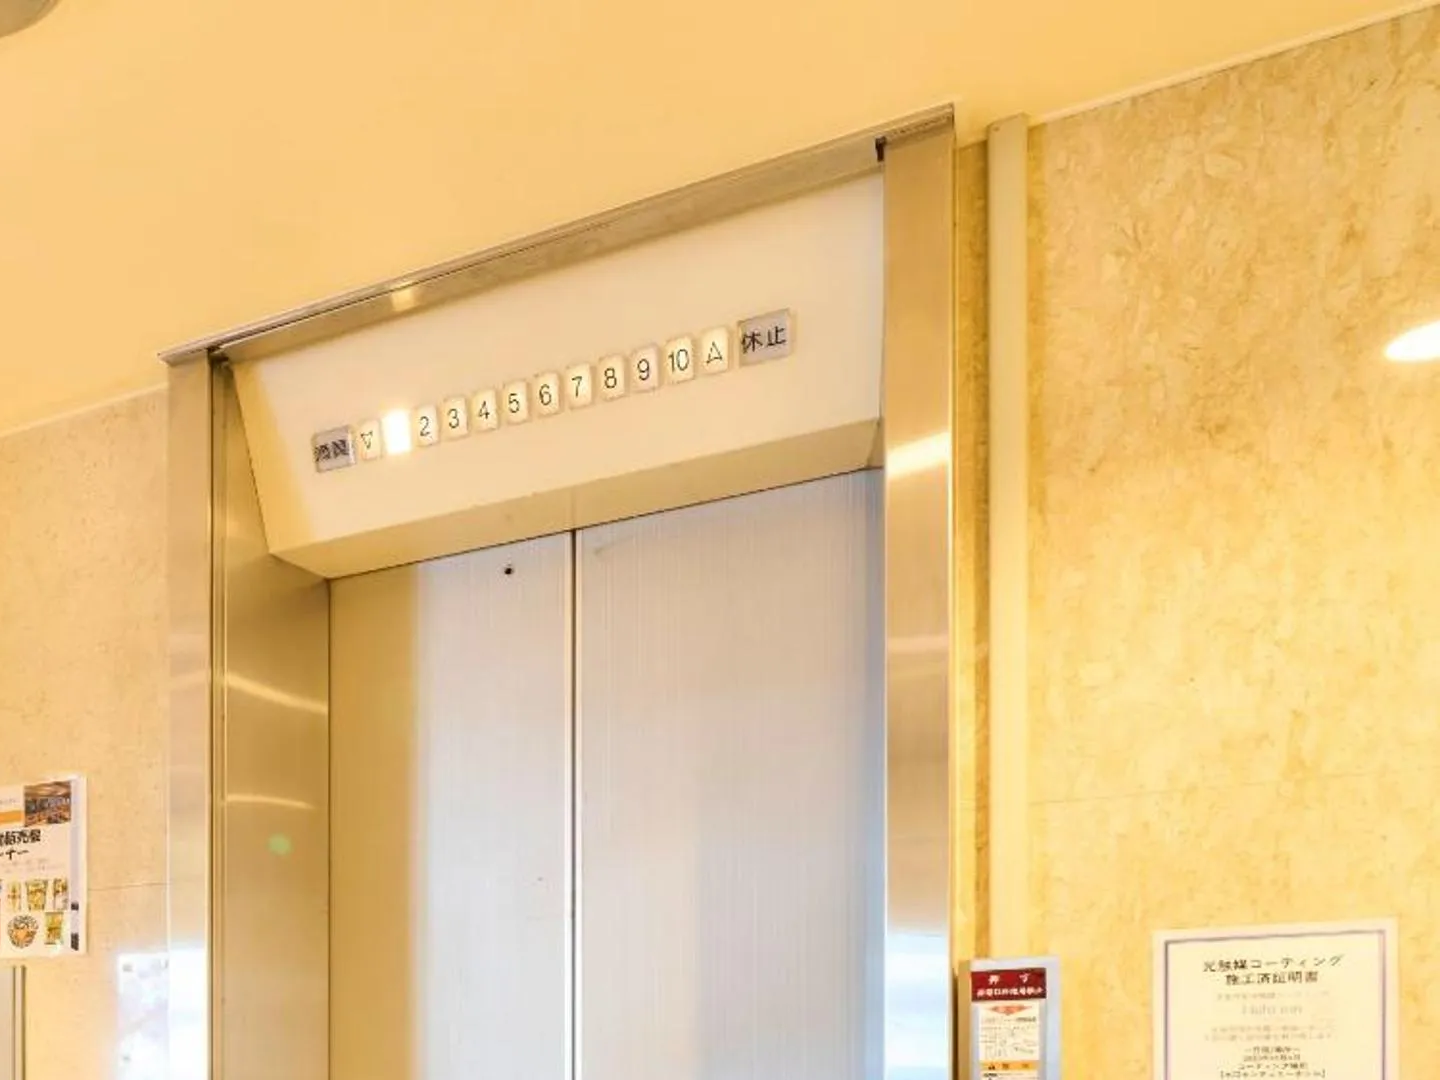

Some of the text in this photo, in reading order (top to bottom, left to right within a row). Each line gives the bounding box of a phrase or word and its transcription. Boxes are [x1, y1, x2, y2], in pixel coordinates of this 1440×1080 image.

[419, 416, 431, 437] 2
[447, 408, 460, 429] 3
[478, 400, 490, 420] 4
[509, 393, 520, 414] 5
[539, 384, 552, 406] 6
[571, 376, 582, 397] 7
[604, 368, 617, 389] 8
[637, 359, 650, 381] 9
[668, 348, 690, 372] 10
[741, 325, 786, 353] 休止
